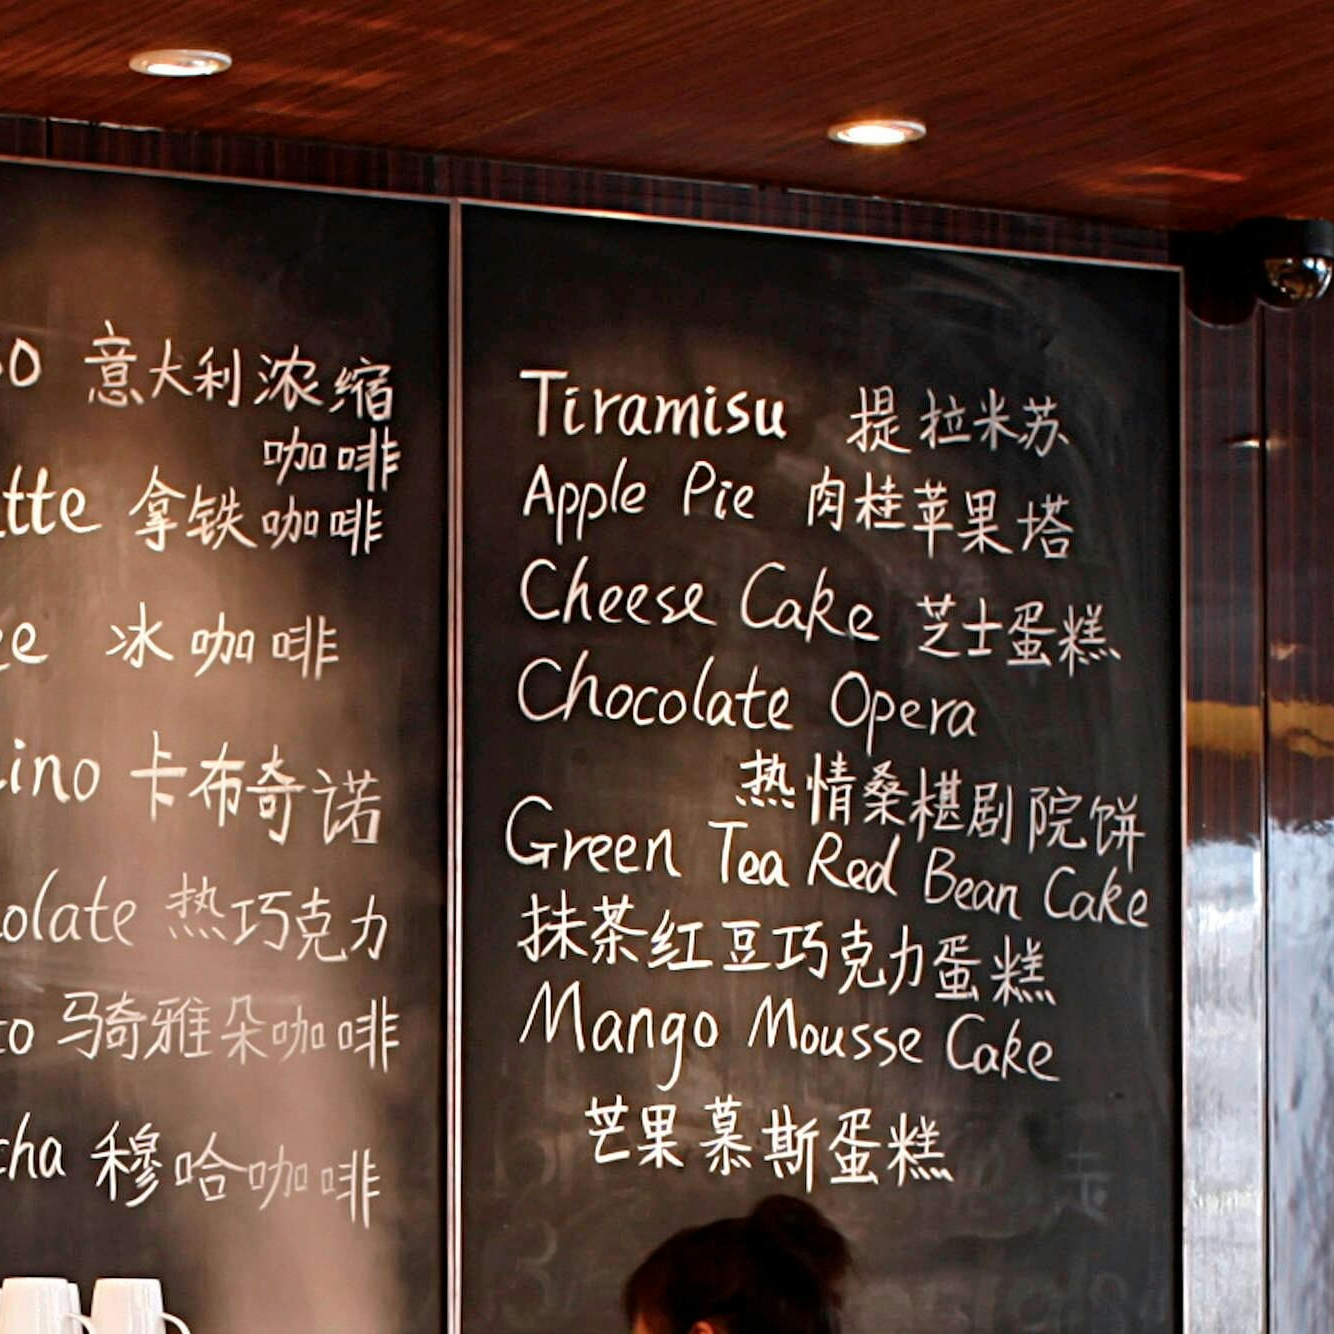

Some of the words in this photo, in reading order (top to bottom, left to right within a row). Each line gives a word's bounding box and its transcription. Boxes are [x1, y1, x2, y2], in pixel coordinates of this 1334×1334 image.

[83, 319, 393, 422] 意大利浓缩
[519, 369, 787, 440] Tiramisu
[845, 385, 1070, 458] 提拉米苏
[128, 465, 384, 557] 拿铁咖啡
[263, 426, 401, 493] 咖啡
[522, 457, 647, 545] Apple
[681, 460, 755, 521] Pie
[807, 465, 1074, 560] 肉桂苹果塔
[106, 601, 340, 681] 冰咖啡
[519, 556, 718, 627] Cheese
[739, 561, 880, 643] Cake
[915, 592, 1122, 679] 芝士蛋糕
[517, 650, 794, 732] Chocolate
[830, 669, 977, 756] Opera
[129, 731, 383, 847] 卡布奇诺
[505, 795, 682, 877] Green
[707, 820, 788, 888] Tea
[806, 831, 900, 898] Red
[923, 848, 1023, 923] Bean
[1043, 866, 1151, 928] Cake
[165, 872, 389, 962] 热巧克力
[516, 889, 1057, 1007] 抹茶红豆巧克力蛋糕
[519, 980, 718, 1091] Mango
[747, 994, 924, 1066] Mousse
[945, 1013, 1062, 1083] Cake
[584, 1094, 955, 1193] 芒果慕斯蛋糕
